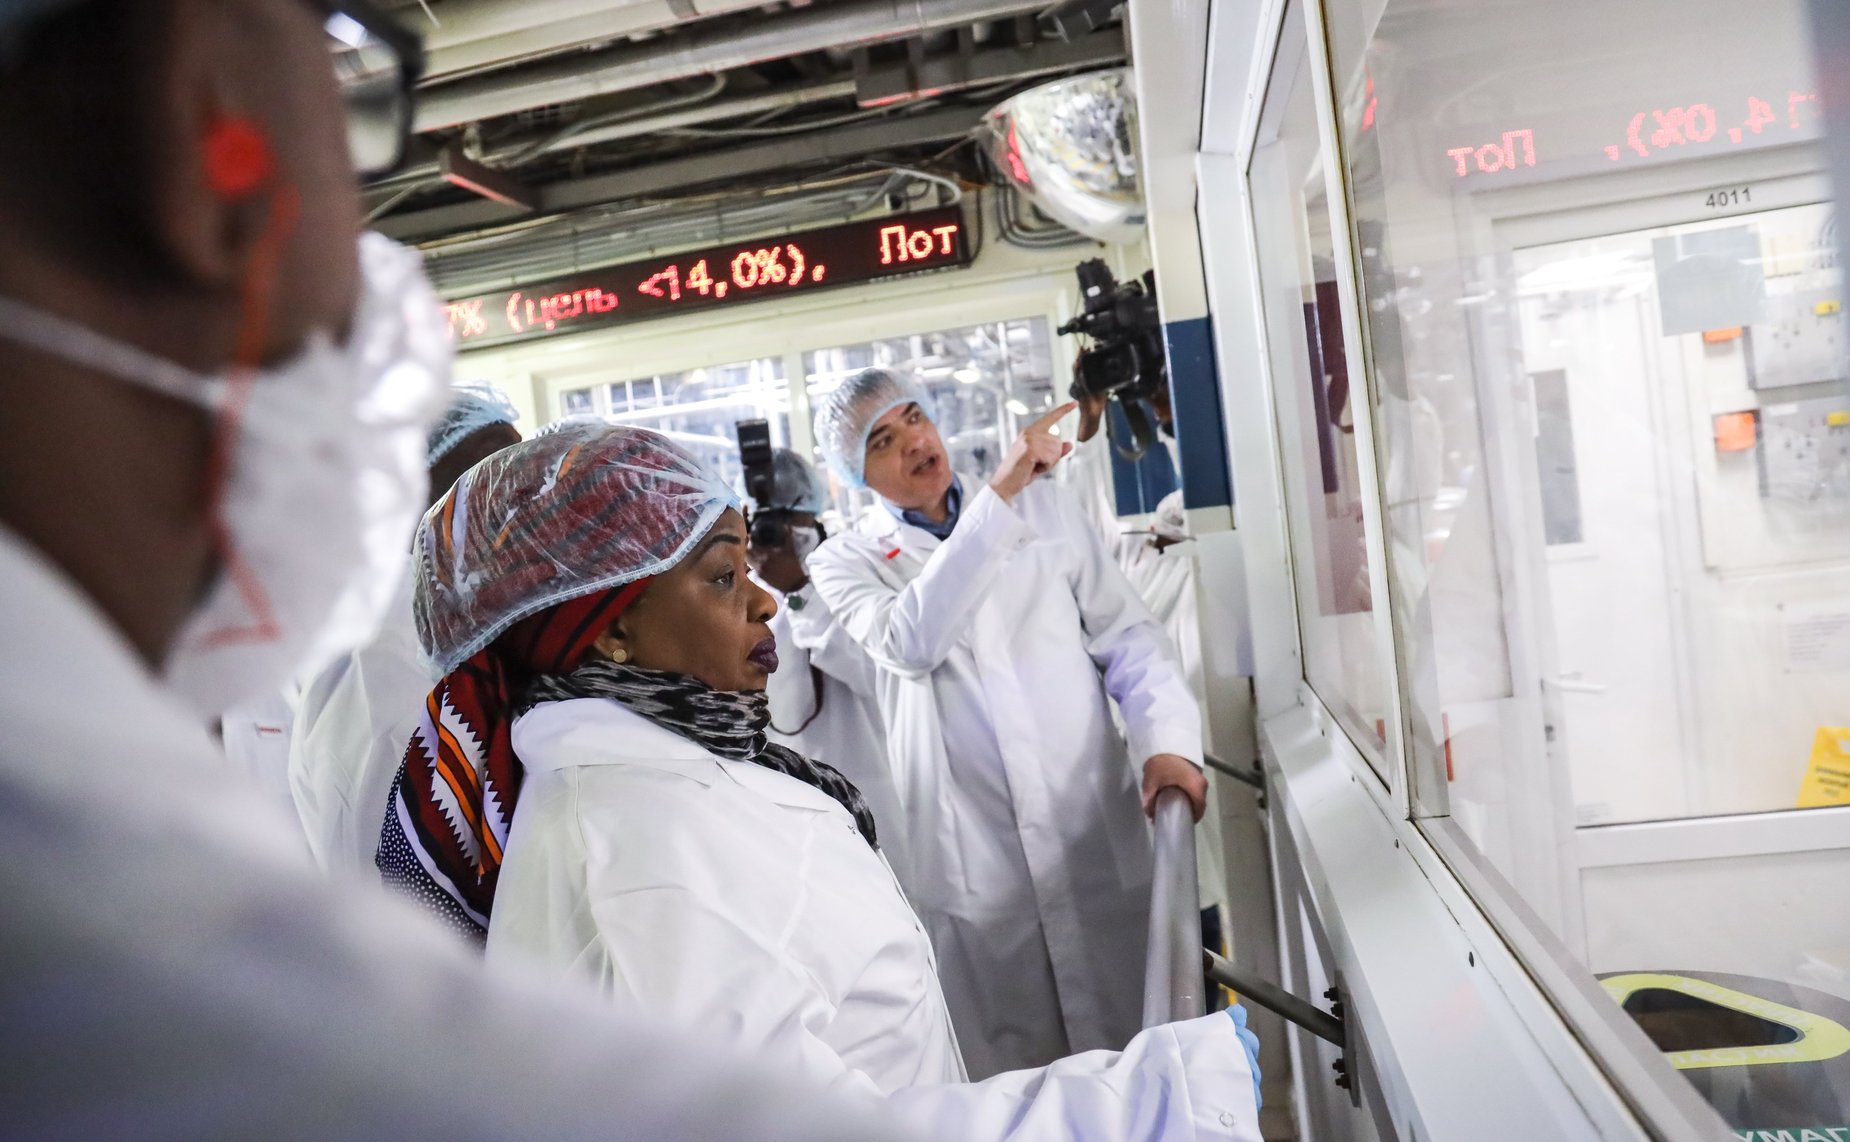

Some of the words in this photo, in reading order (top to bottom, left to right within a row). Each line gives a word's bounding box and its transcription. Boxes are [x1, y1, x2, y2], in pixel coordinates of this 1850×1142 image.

[1705, 187, 1751, 208] 4011
[505, 288, 619, 332] (цель
[879, 224, 959, 264] Пот
